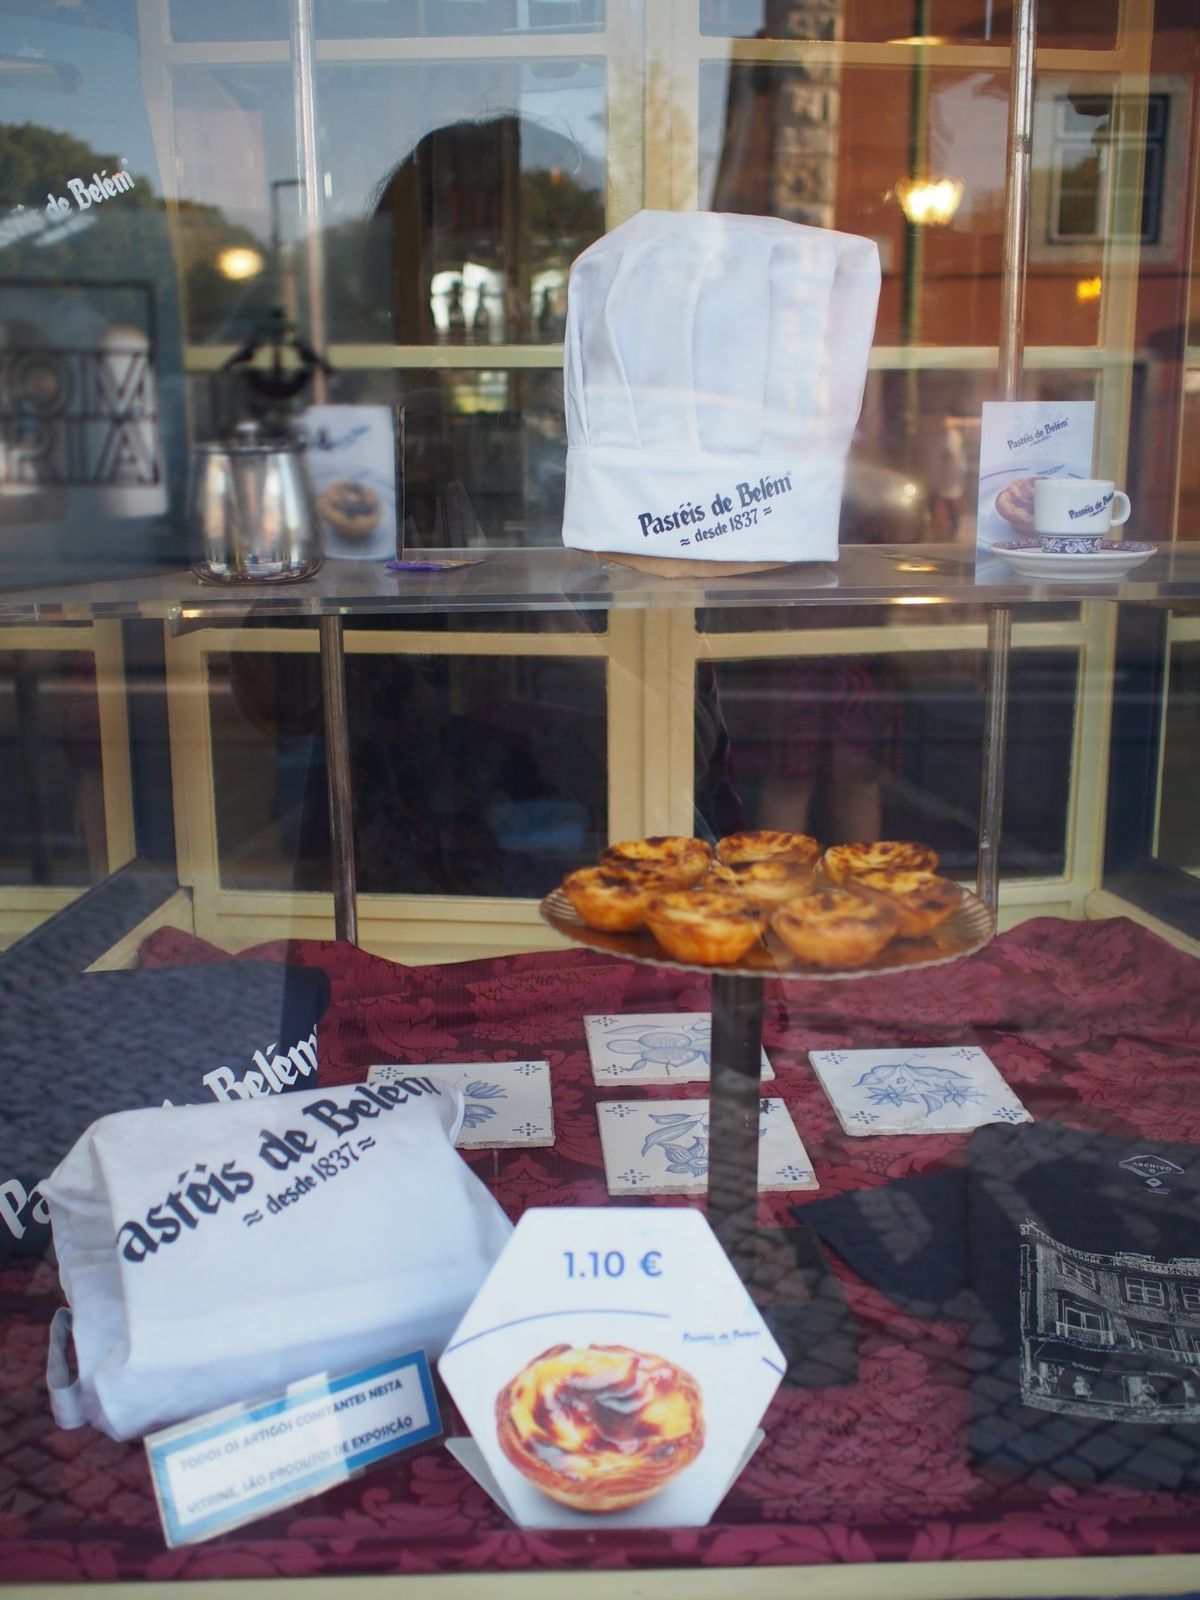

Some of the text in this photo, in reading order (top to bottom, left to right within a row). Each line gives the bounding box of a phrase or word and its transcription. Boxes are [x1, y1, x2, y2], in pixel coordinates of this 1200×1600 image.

[67, 169, 135, 211] Belém
[1035, 429, 1044, 439] de
[638, 502, 706, 537] Pastéis
[711, 493, 734, 517] de
[695, 508, 759, 542] desde 1837
[259, 1129, 317, 1171] de
[267, 1142, 360, 1215] desde 1837
[563, 1250, 663, 1278] 1.10 €
[181, 1449, 222, 1471] TODOS
[225, 1441, 240, 1455] OS
[243, 1422, 294, 1449] ARTIGOS
[369, 1379, 404, 1400] NESTA
[269, 1452, 332, 1482] PRODUTOS
[334, 1440, 350, 1457] DE
[352, 1415, 414, 1449] EXPOSIÇÃO
